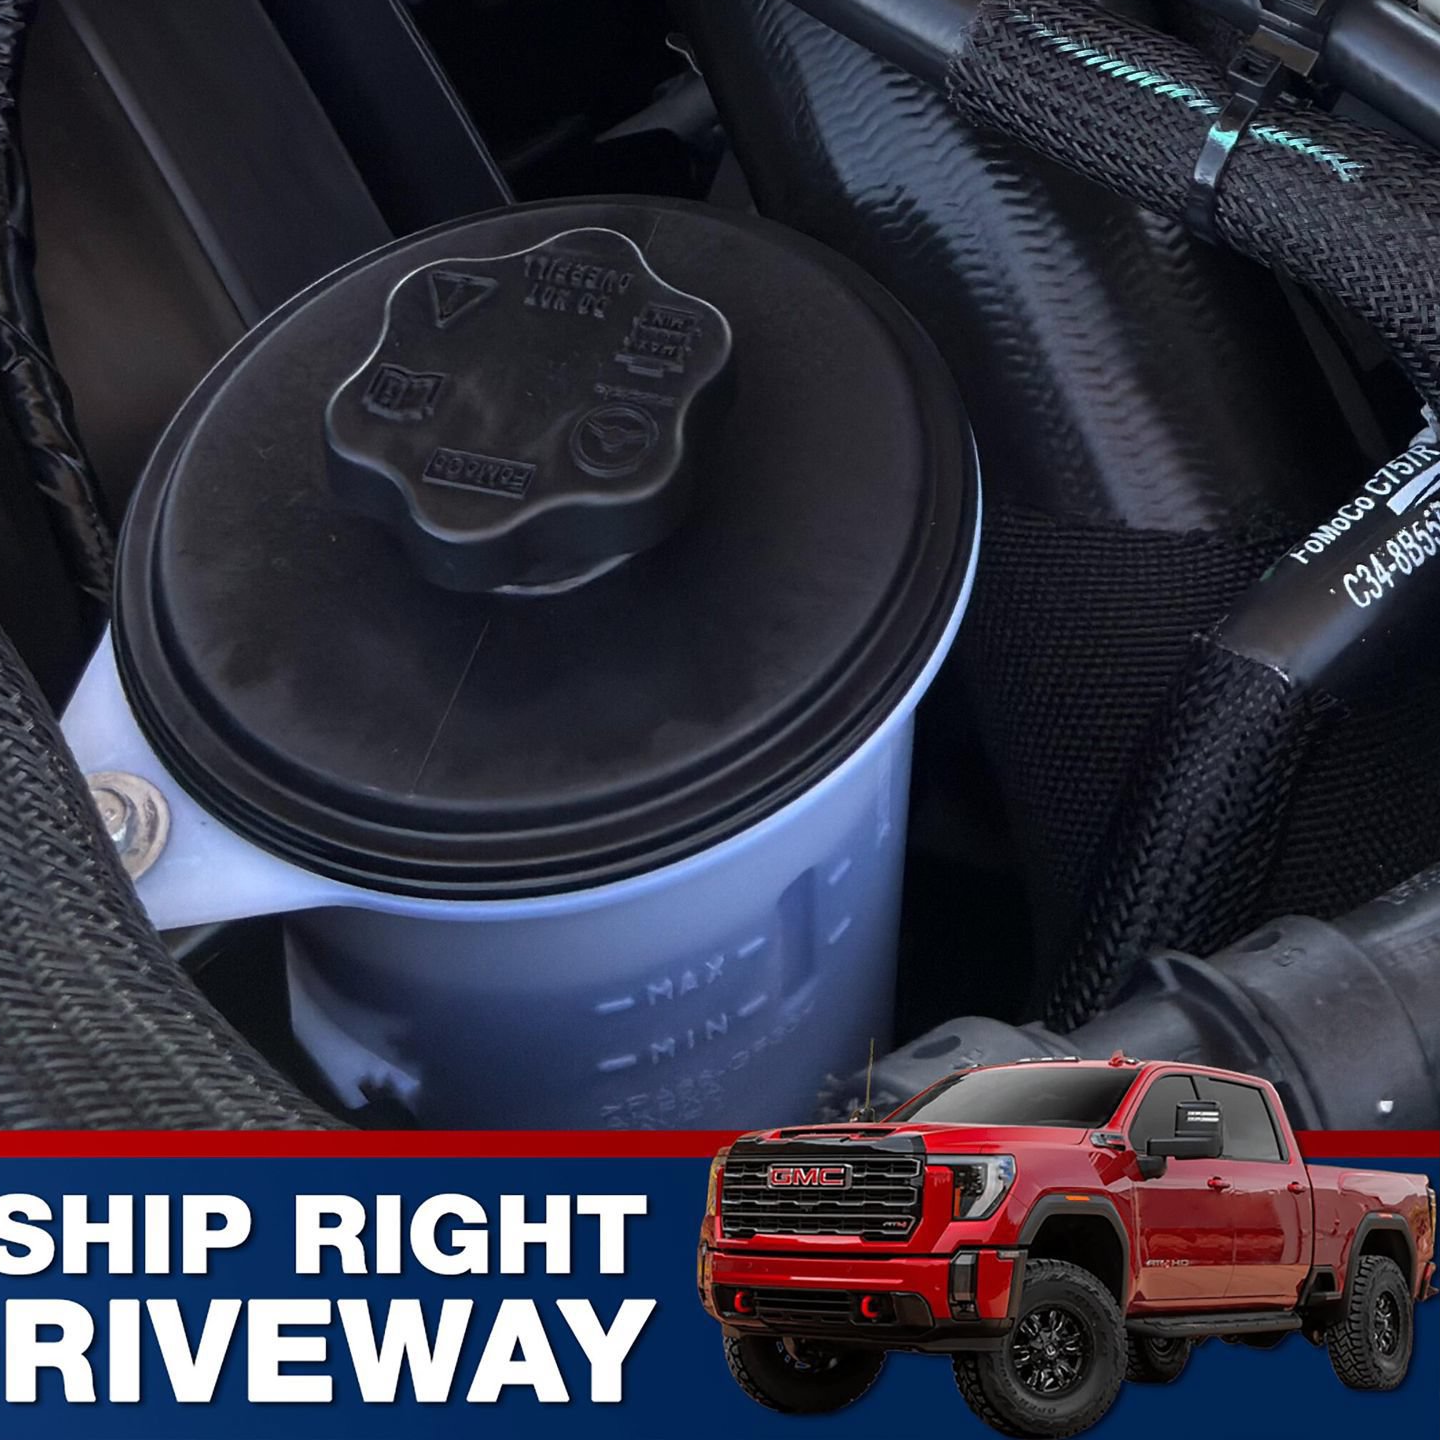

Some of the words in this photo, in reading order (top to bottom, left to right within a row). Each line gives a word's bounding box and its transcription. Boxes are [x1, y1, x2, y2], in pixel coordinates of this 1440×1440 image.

[523, 255, 633, 294] OVERFILL
[523, 284, 571, 312] NOT
[433, 455, 528, 487] FoMoCo
[1365, 444, 1440, 496] C757R
[647, 954, 724, 1005] MAX
[651, 1013, 728, 1064] MIN
